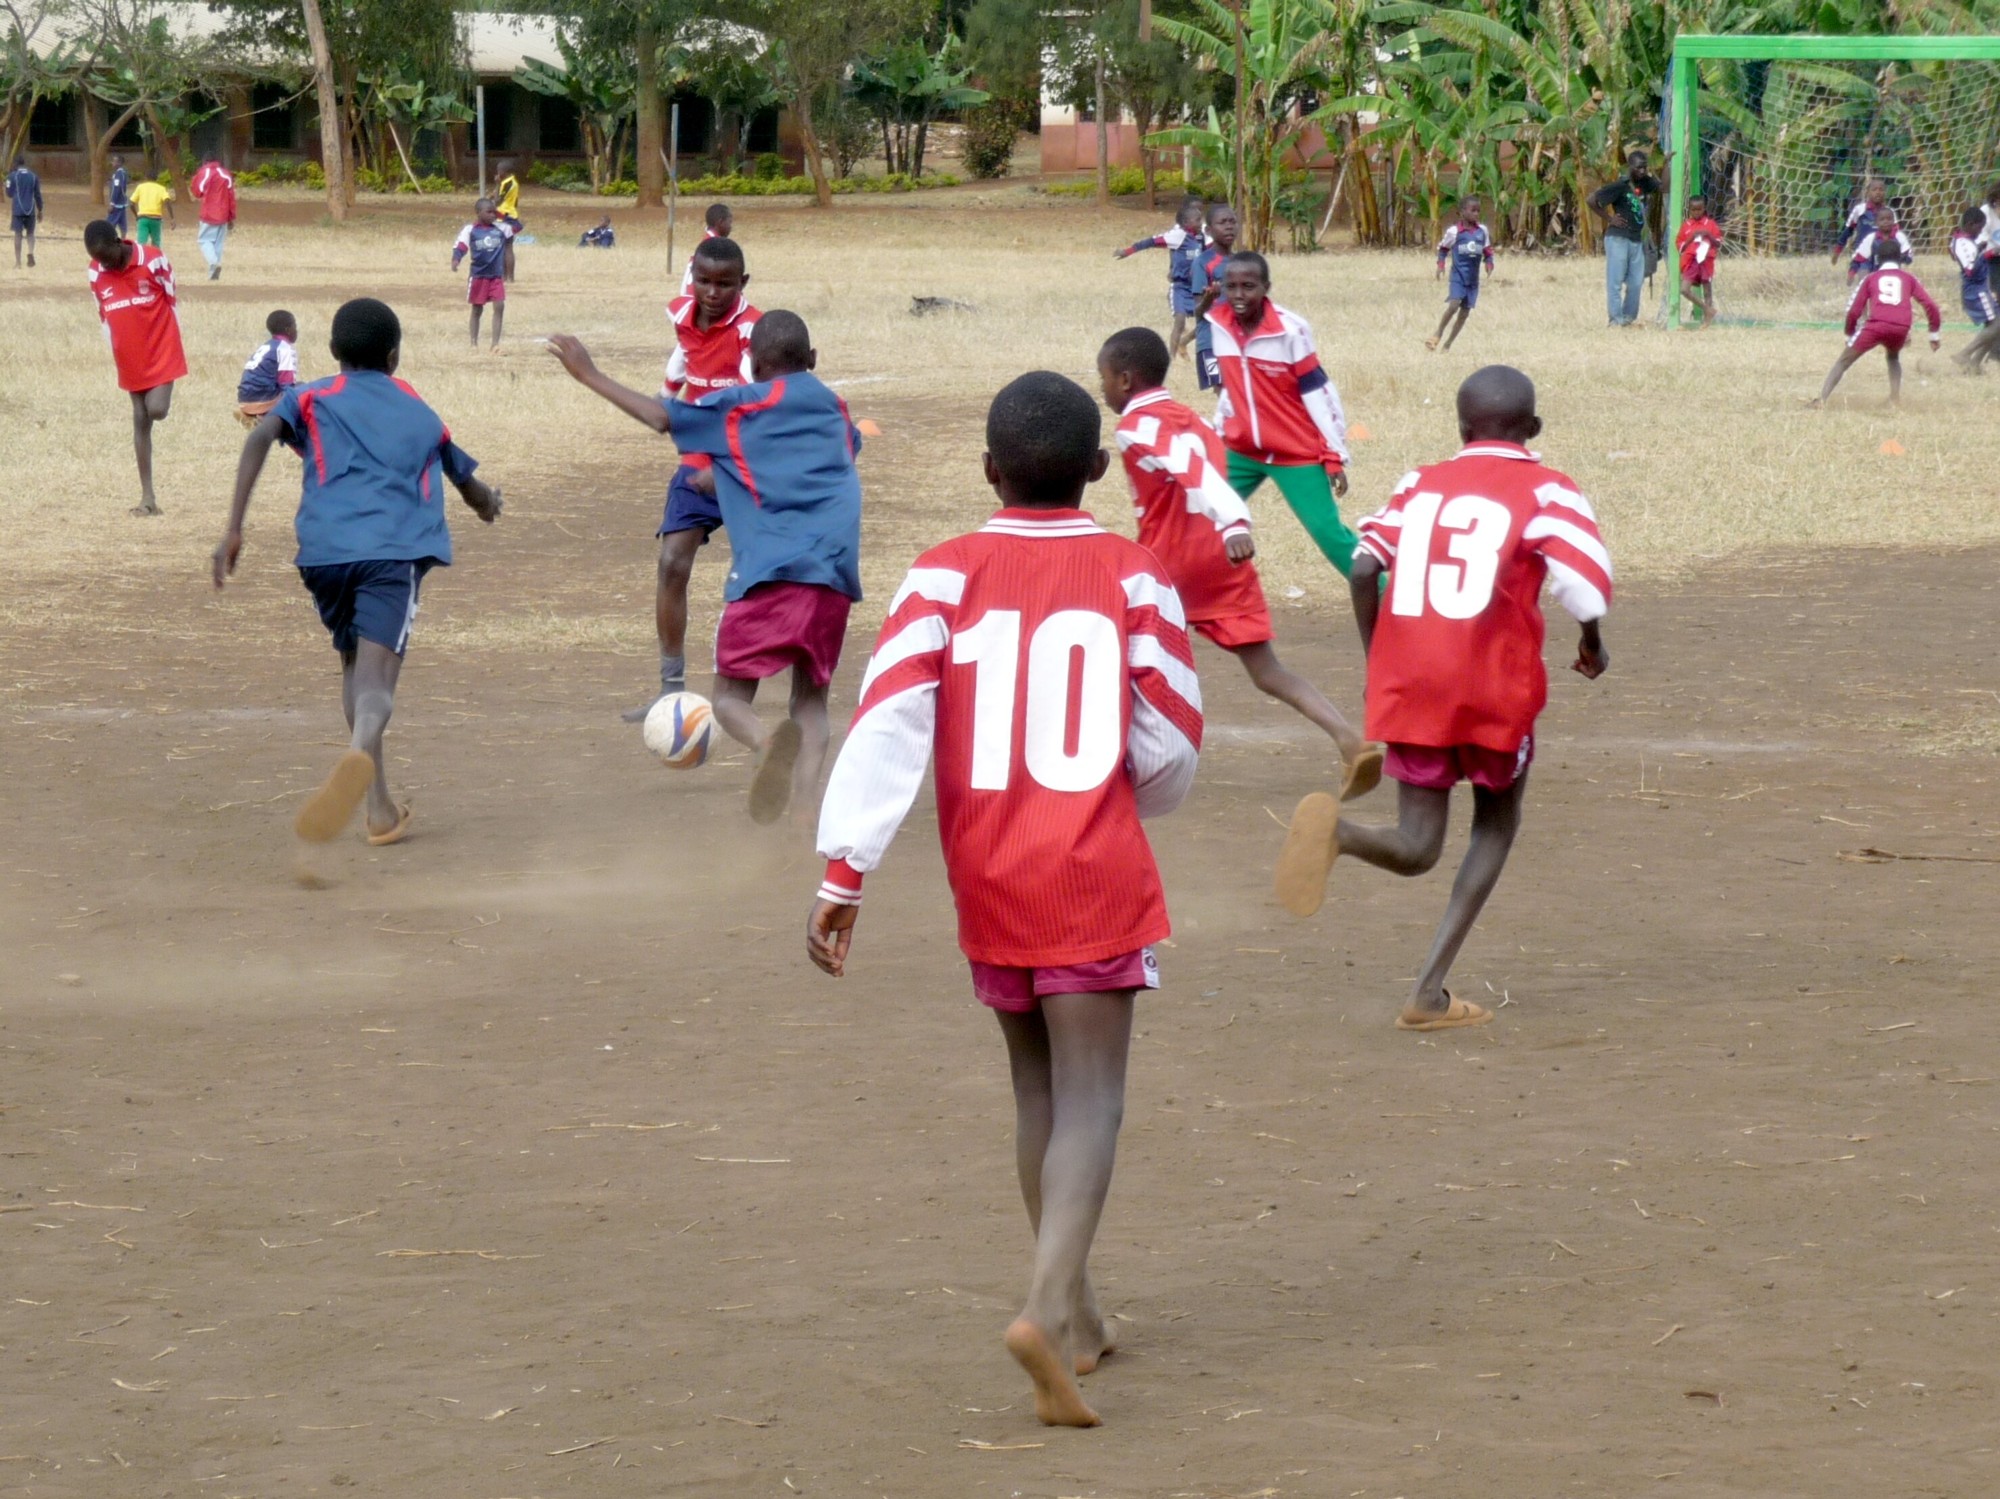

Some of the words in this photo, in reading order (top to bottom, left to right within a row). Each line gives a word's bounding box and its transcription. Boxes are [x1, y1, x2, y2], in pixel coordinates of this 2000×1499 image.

[1879, 276, 1901, 305] 9
[1391, 491, 1512, 619] 13
[952, 609, 1121, 792] 10
